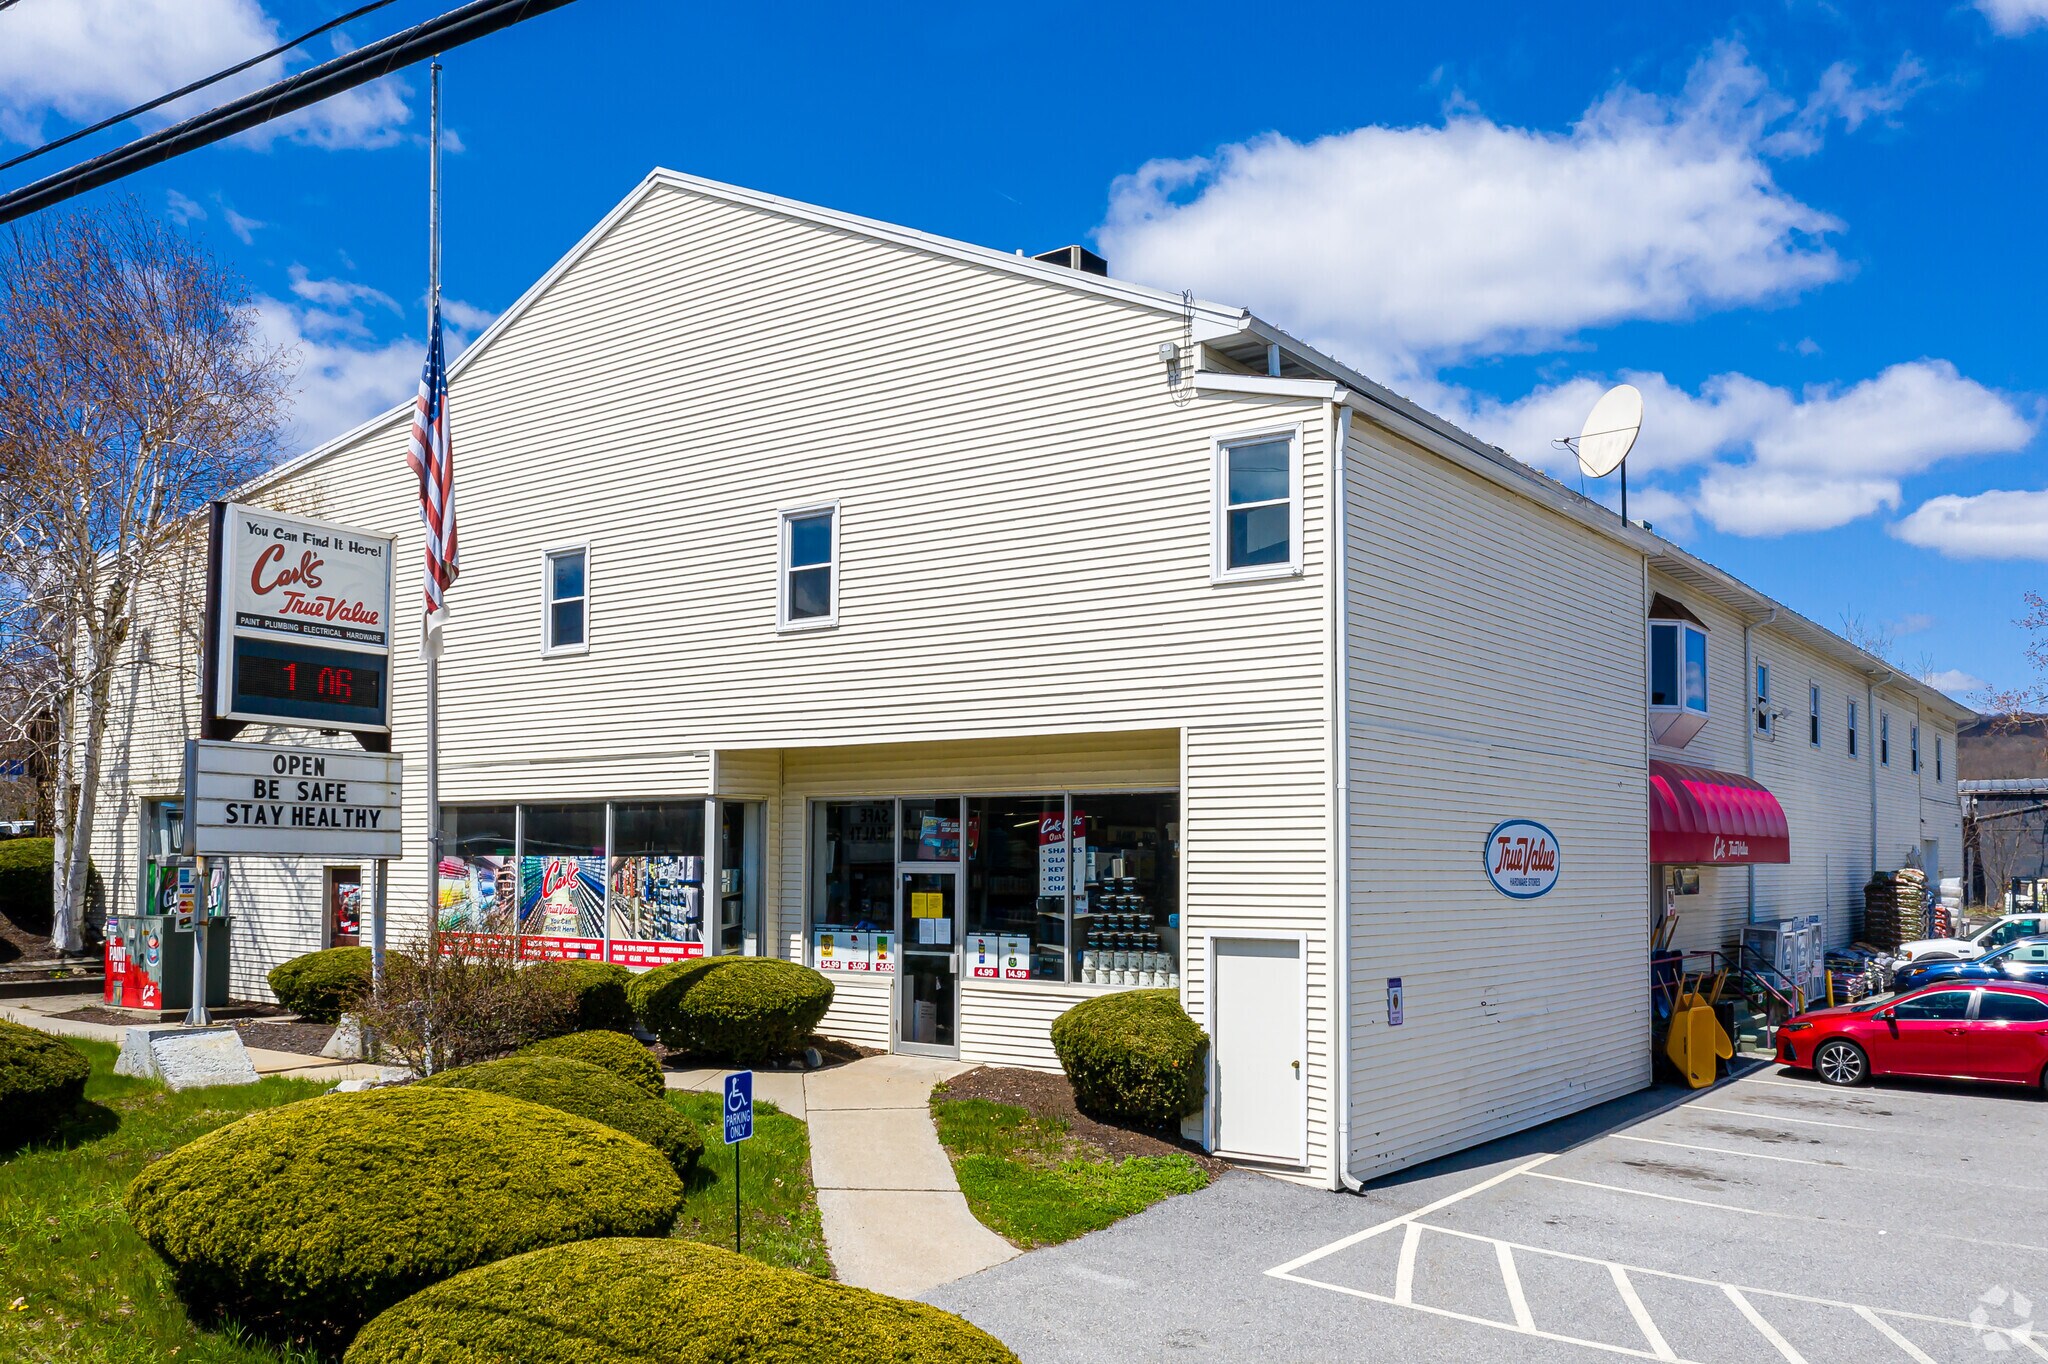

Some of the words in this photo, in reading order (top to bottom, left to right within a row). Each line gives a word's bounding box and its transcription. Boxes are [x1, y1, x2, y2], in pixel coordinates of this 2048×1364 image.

[246, 521, 268, 537] You
[273, 527, 298, 542] Can
[302, 532, 329, 548] Find
[334, 538, 343, 550] It
[348, 541, 382, 557] Here!
[251, 543, 324, 595] Carl's
[240, 616, 260, 626] PAINT
[264, 620, 299, 631] PLUMBING
[303, 625, 342, 637] ELECTRICAL
[346, 631, 381, 642] HARDWARE
[273, 754, 325, 777] OPEN
[254, 779, 280, 800] BE
[297, 781, 347, 802] SAFE
[226, 803, 284, 826] STAY
[292, 806, 381, 828] HEALTHY
[1048, 847, 1083, 855] SHAES
[542, 860, 579, 899] Carl's
[109, 946, 126, 961] PAINT
[113, 962, 118, 972] IT
[118, 962, 126, 973] ALL
[822, 960, 840, 968] 34.99
[1007, 970, 1027, 978] 14.99
[726, 1110, 750, 1127] PARKING
[730, 1123, 746, 1138] ONLY
